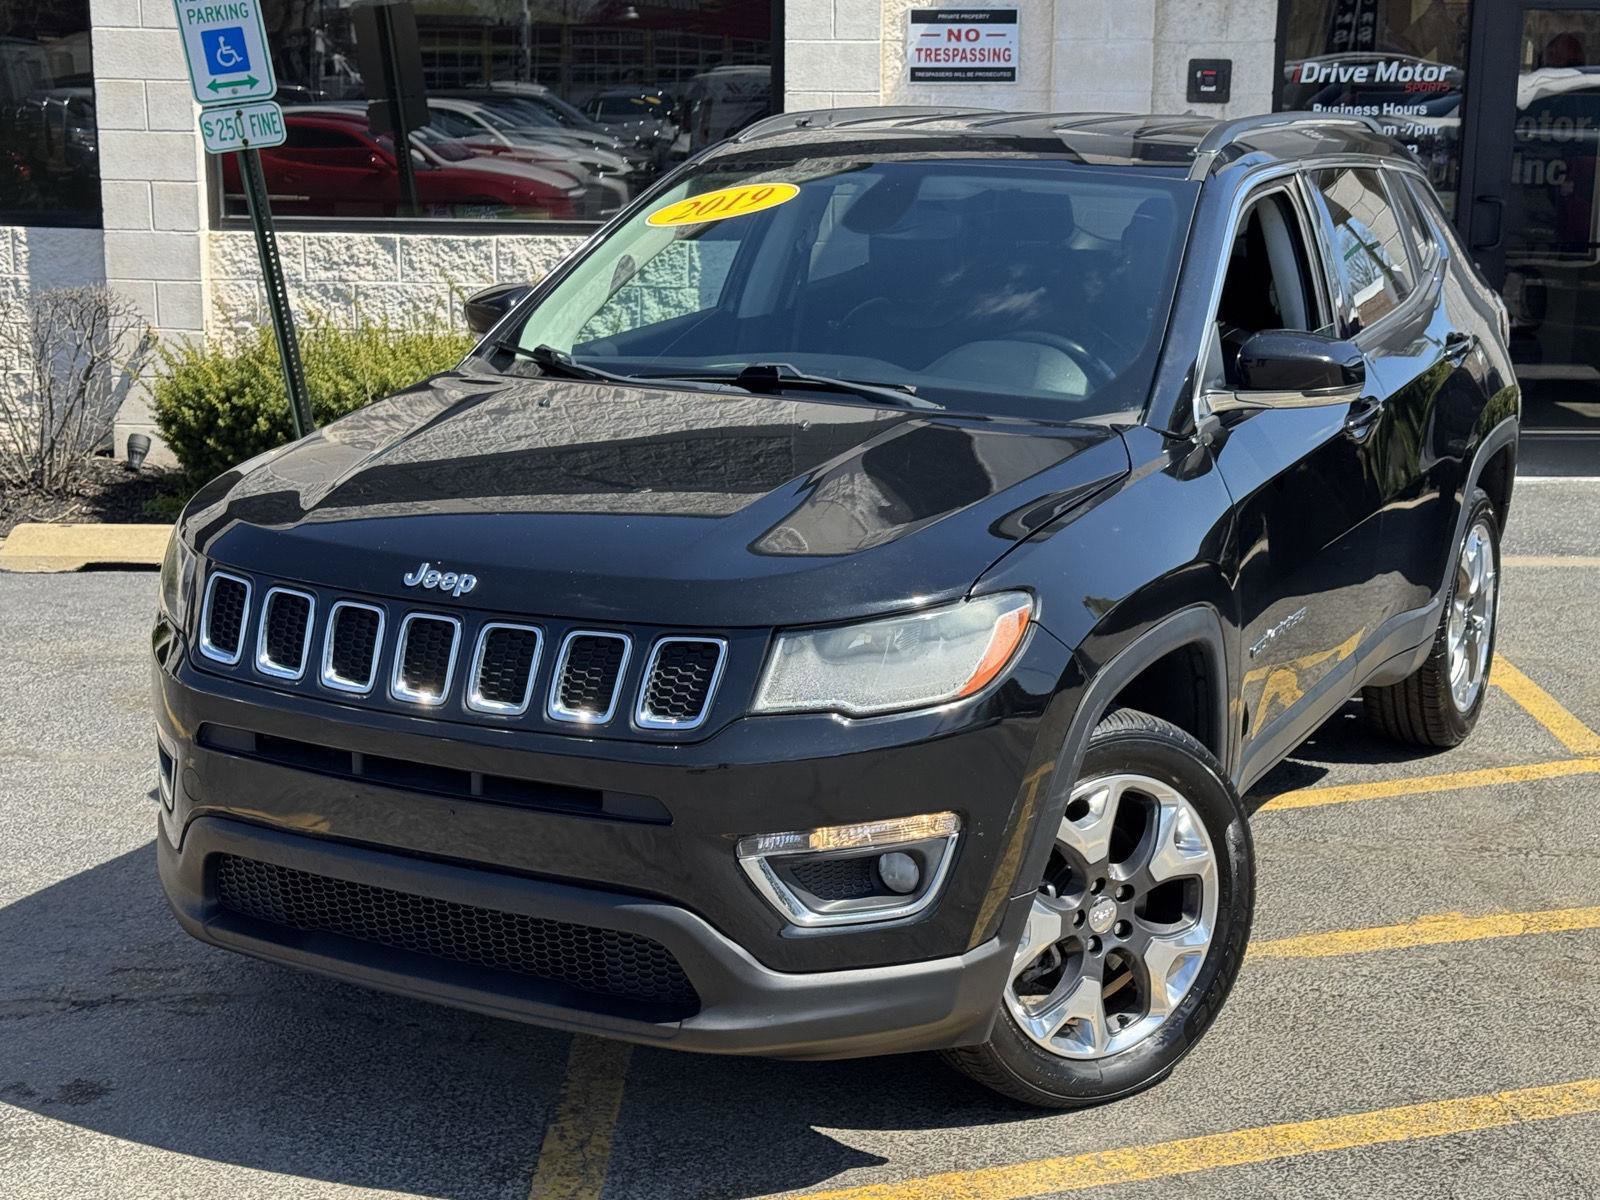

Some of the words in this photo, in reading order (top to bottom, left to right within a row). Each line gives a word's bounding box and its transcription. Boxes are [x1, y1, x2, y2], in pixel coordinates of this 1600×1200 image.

[186, 2, 249, 24] PARKING
[946, 28, 980, 42] NO
[915, 47, 1012, 62] TRESPASSING
[1374, 62, 1451, 83] Motor
[1404, 82, 1450, 93] SPORTS
[1312, 103, 1379, 116] Business
[1382, 103, 1427, 116] Hours
[249, 111, 281, 138] FINE
[1515, 110, 1592, 142] otor
[667, 187, 775, 222] 2019
[404, 562, 477, 597] Jeep
